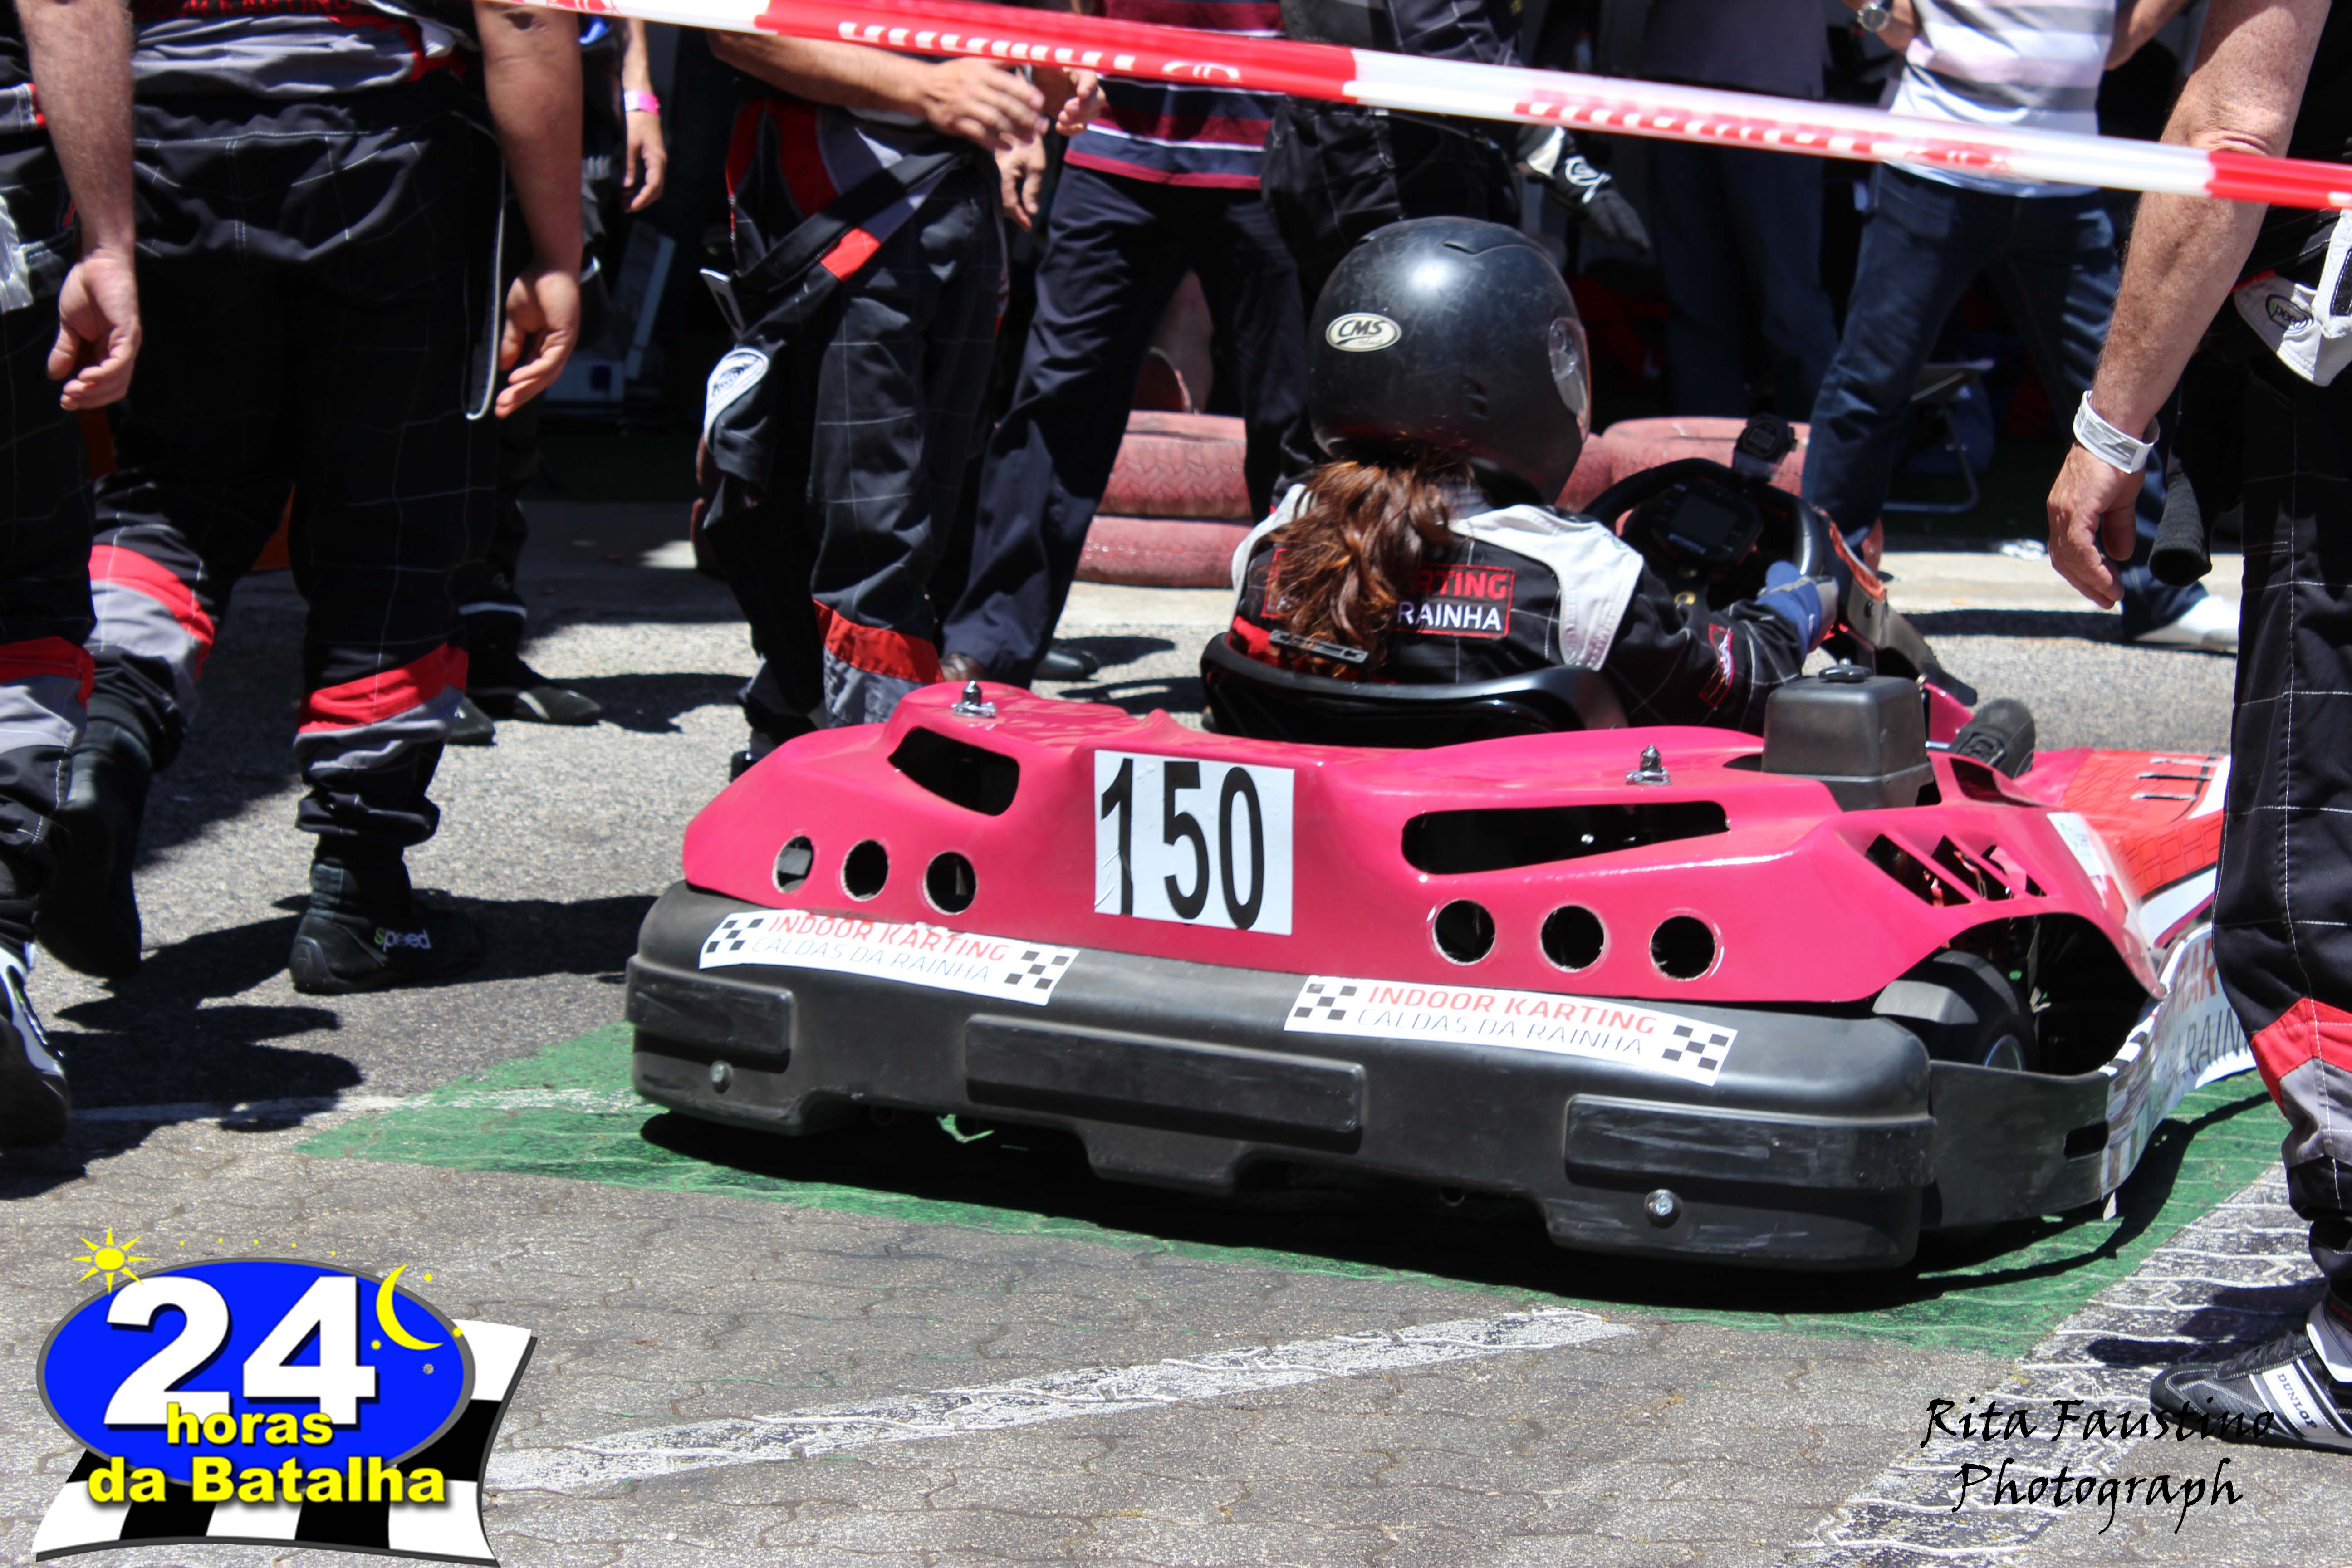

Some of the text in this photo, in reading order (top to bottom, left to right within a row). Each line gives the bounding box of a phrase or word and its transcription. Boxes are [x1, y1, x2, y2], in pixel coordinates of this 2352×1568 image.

[1339, 319, 1387, 337] CMS
[1416, 570, 1507, 599] RTING
[1396, 600, 1502, 631] RAINHA
[1101, 758, 1264, 930] 150
[752, 937, 990, 982] CALDAS DA RAINHA
[767, 915, 1010, 961] INDOOR KARTING
[1358, 1008, 1642, 1055] CALDAS DA RAINHA
[1367, 986, 1657, 1034] INDOOR KARTING
[2277, 1373, 2318, 1429] DUNLOP
